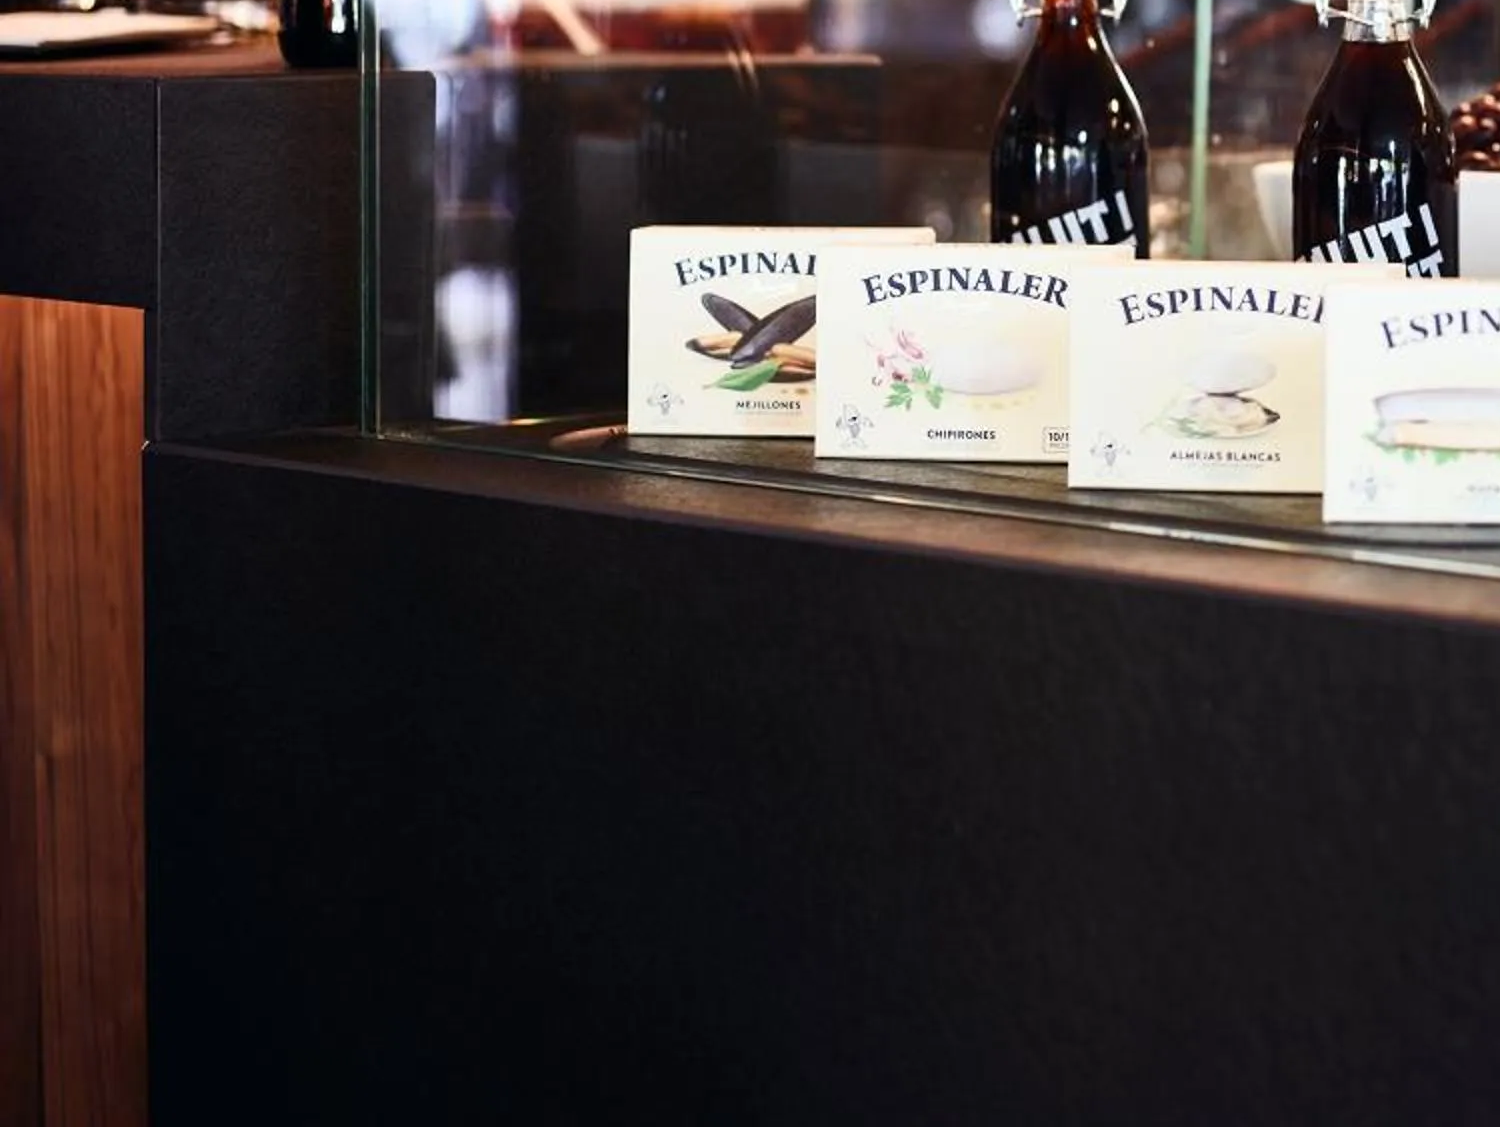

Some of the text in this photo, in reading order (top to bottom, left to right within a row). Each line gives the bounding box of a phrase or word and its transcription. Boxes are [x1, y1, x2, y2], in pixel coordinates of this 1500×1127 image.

[861, 267, 1069, 309] ESPINALER
[736, 400, 801, 410] MEJILLONES
[927, 429, 997, 440] CHIPIRONES
[1226, 452, 1281, 462] BLANCAS
